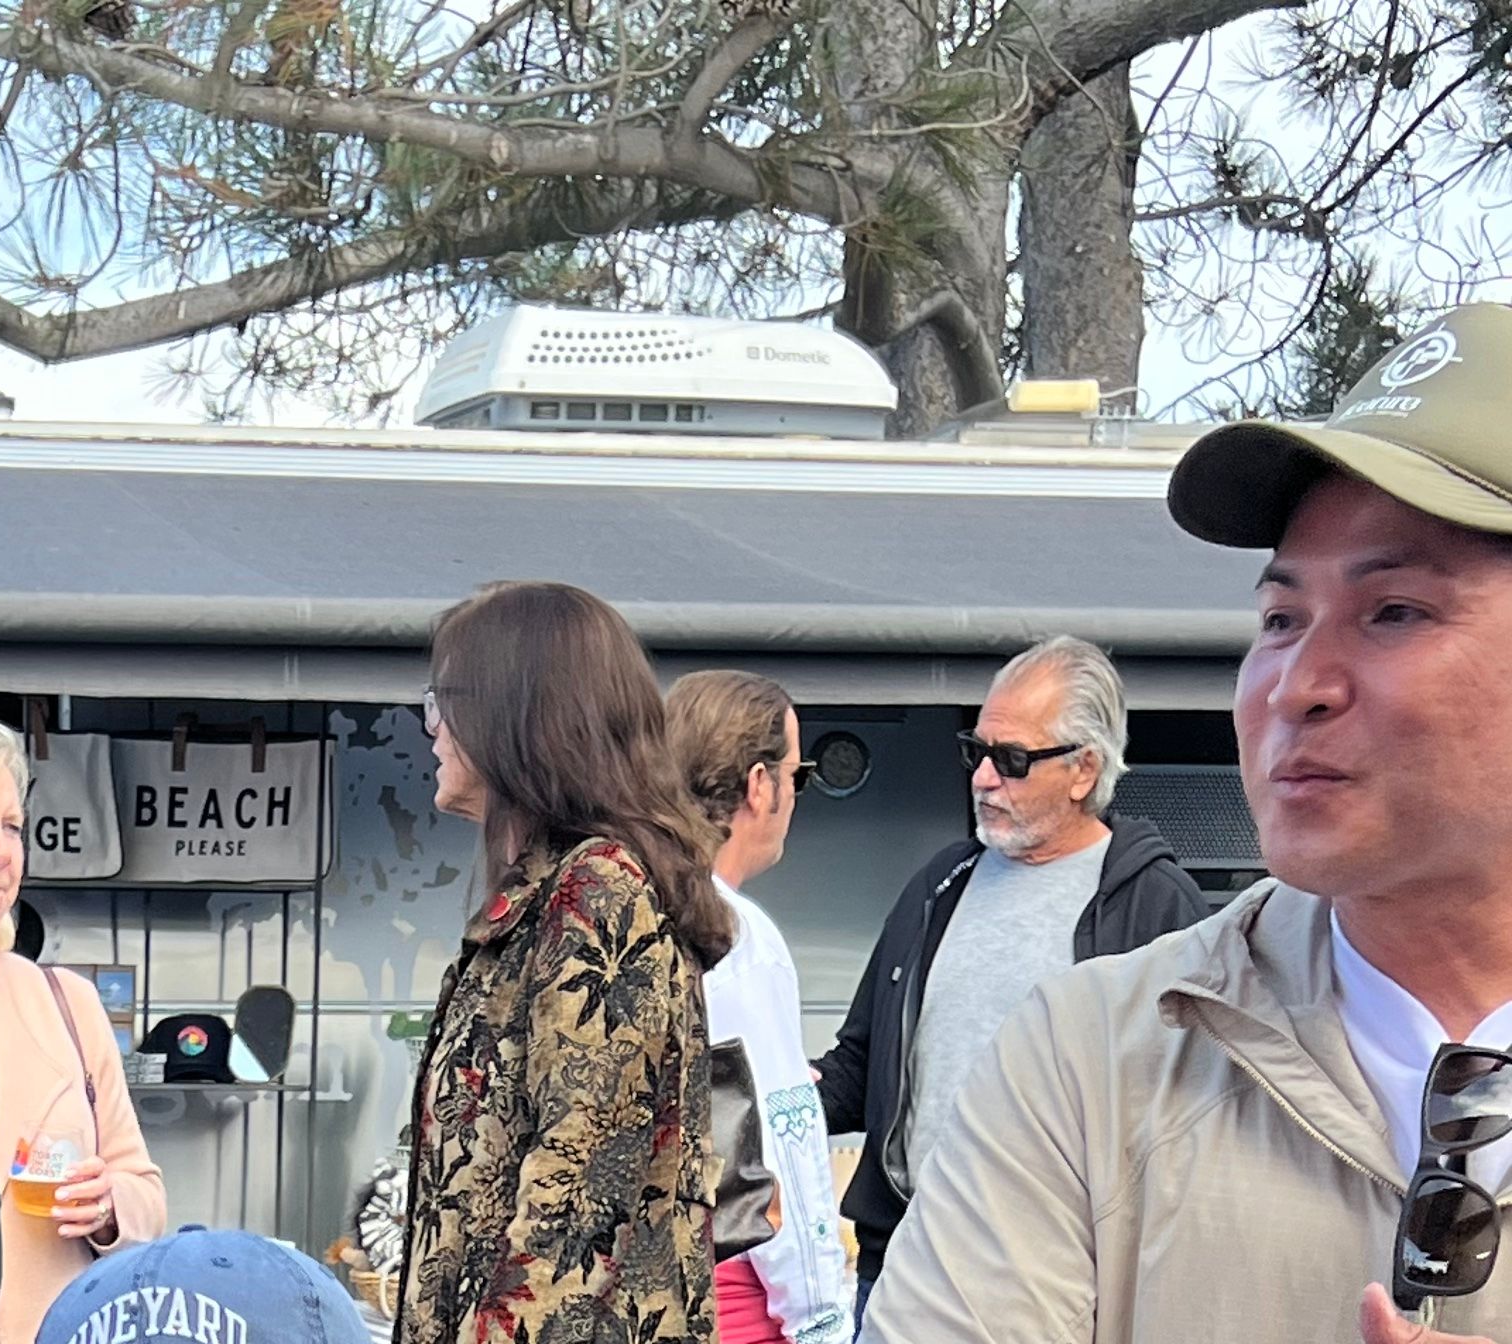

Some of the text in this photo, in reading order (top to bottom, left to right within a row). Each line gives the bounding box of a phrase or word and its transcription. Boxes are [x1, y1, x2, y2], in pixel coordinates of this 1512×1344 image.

[763, 345, 831, 365] Dometic
[134, 784, 292, 829] BEACH
[34, 815, 82, 854] GE
[174, 839, 247, 857] PLEASE
